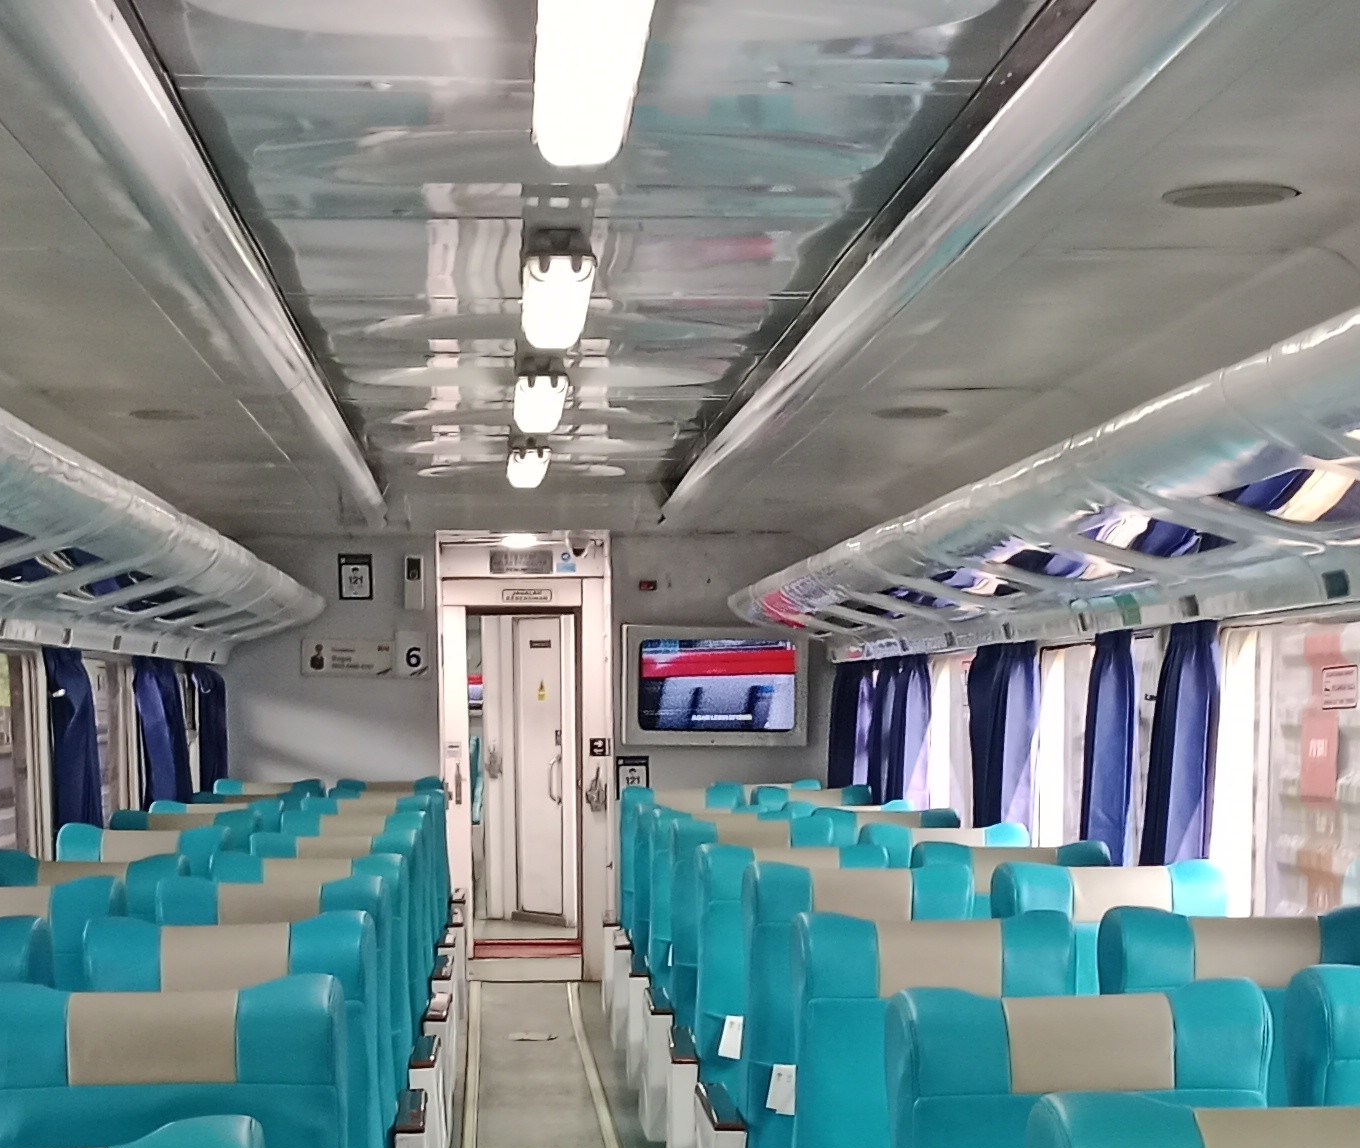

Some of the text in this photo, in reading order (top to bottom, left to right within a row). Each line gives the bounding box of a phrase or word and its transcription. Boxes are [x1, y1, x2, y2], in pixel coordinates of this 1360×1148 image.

[349, 576, 364, 585] 121
[406, 646, 422, 668] 6
[625, 776, 640, 785] 121
